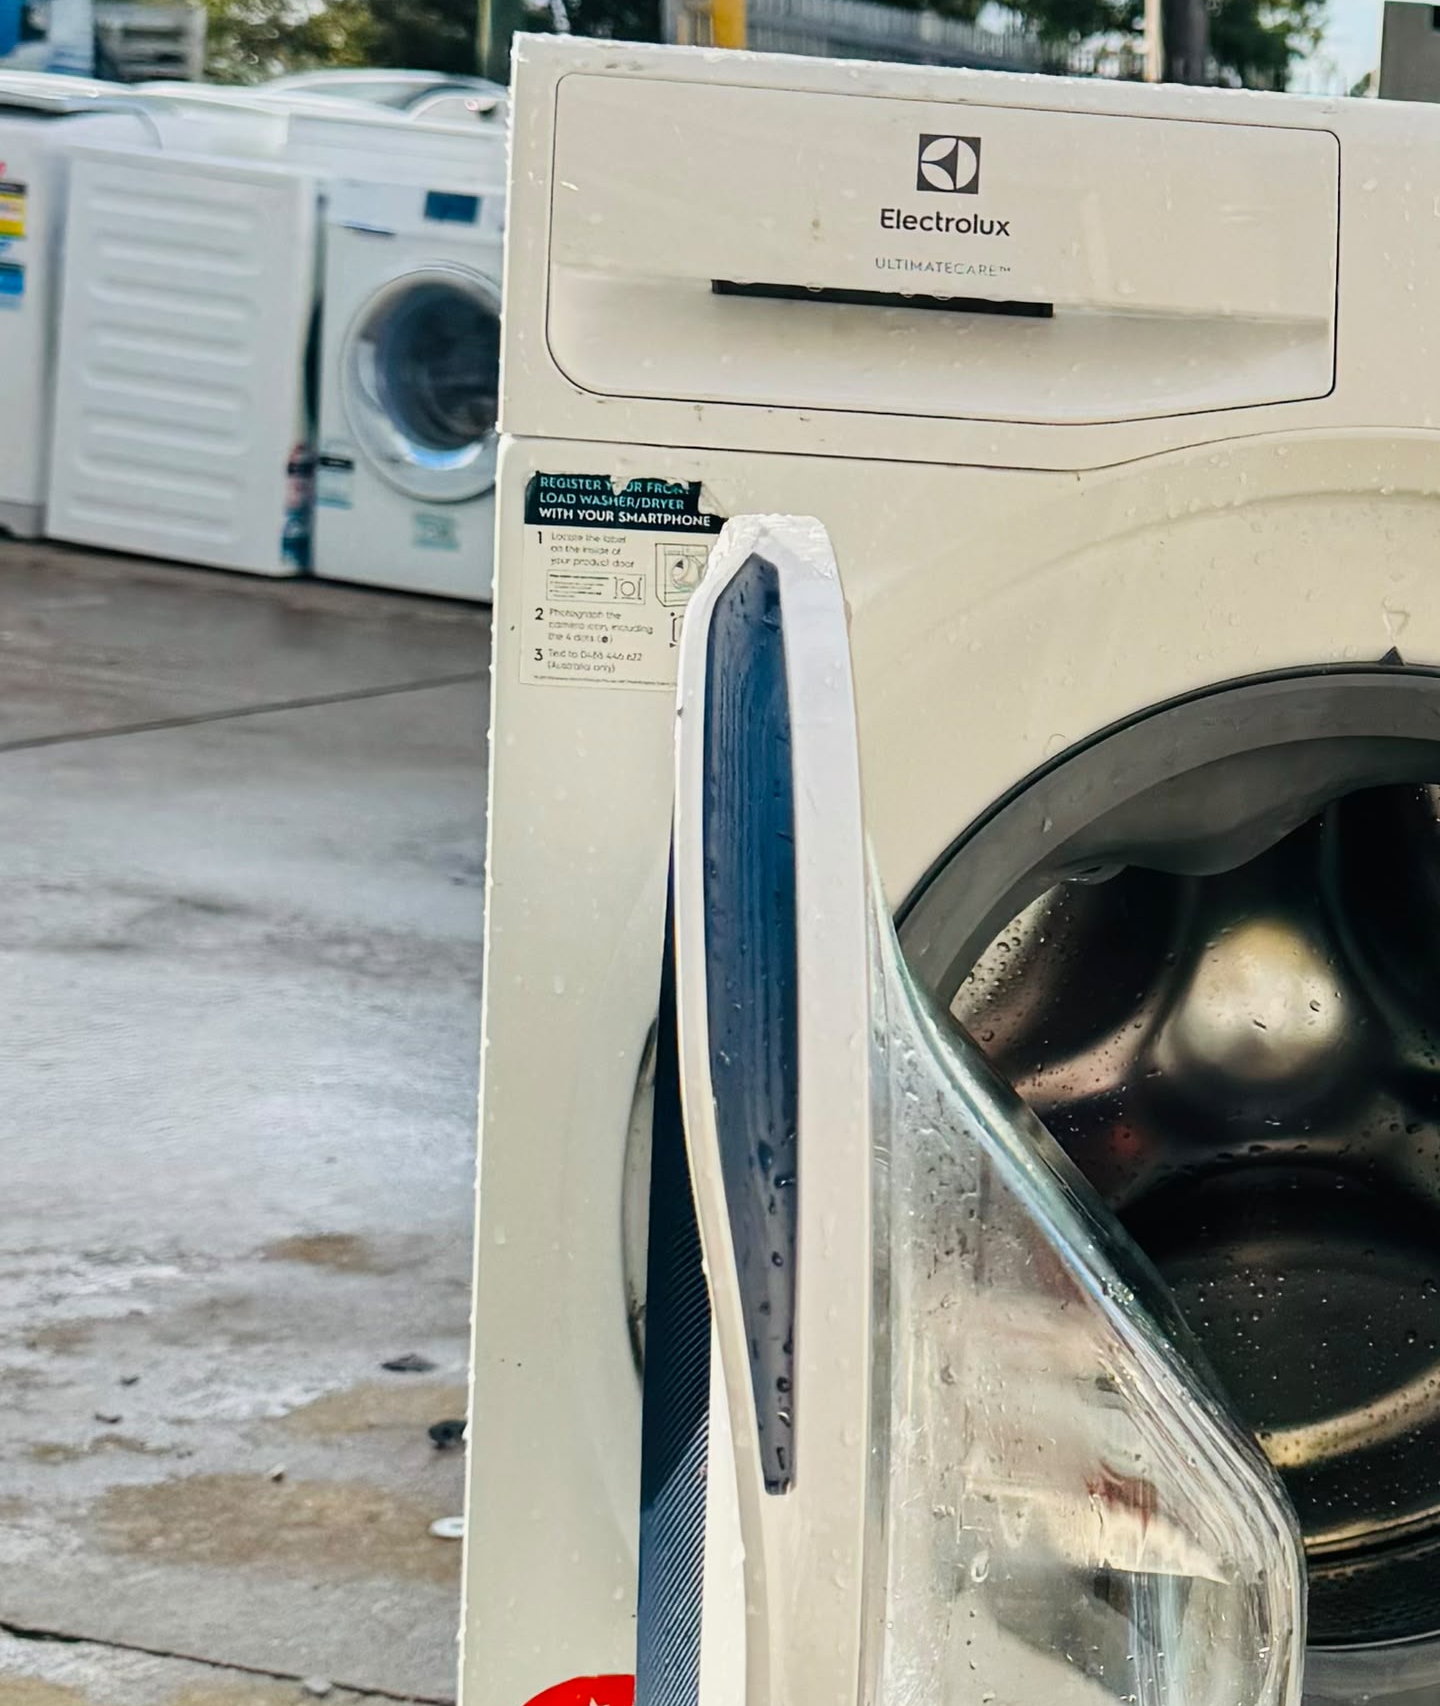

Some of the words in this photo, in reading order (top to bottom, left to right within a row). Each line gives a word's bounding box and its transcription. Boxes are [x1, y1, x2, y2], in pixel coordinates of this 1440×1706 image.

[880, 208, 1010, 236] Electrolux
[540, 476, 601, 491] REGISTER
[605, 479, 642, 493] YUR
[540, 491, 576, 505] LOAD
[580, 494, 684, 510] WASHER/DRYER
[539, 507, 573, 520] WITH
[577, 509, 614, 523] YOUR
[618, 511, 712, 527] SMARTPHONE
[537, 531, 542, 544] 1
[585, 533, 600, 542] the
[565, 545, 581, 554] the
[551, 558, 570, 567] your
[535, 607, 544, 621] 2
[606, 609, 621, 619] the
[534, 648, 543, 661] 3
